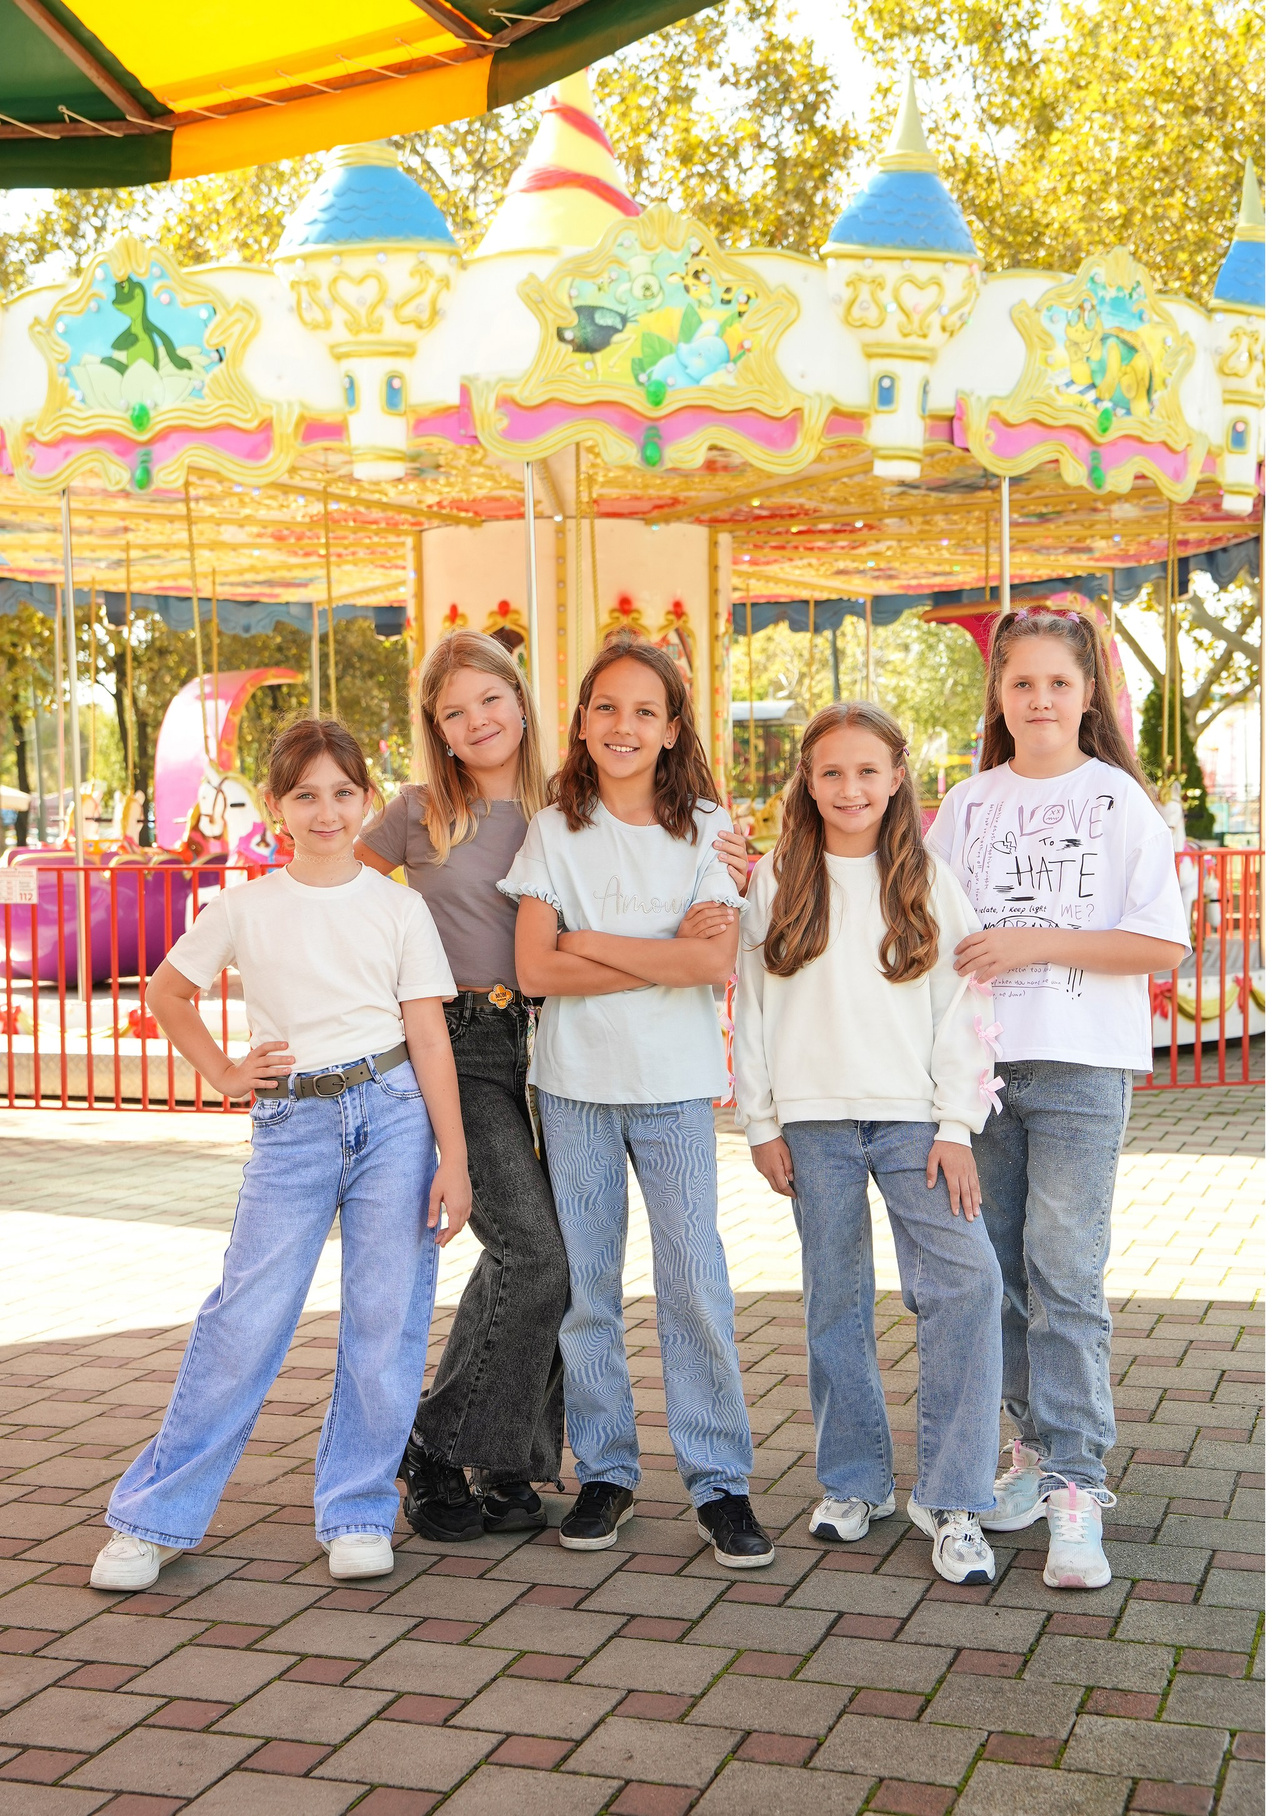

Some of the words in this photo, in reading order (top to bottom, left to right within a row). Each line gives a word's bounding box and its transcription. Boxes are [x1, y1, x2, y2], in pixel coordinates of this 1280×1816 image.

[1018, 798, 1105, 839] LOVE
[1006, 853, 1098, 898] HATE
[20, 892, 33, 901] 112
[1060, 903, 1095, 921] ME?
